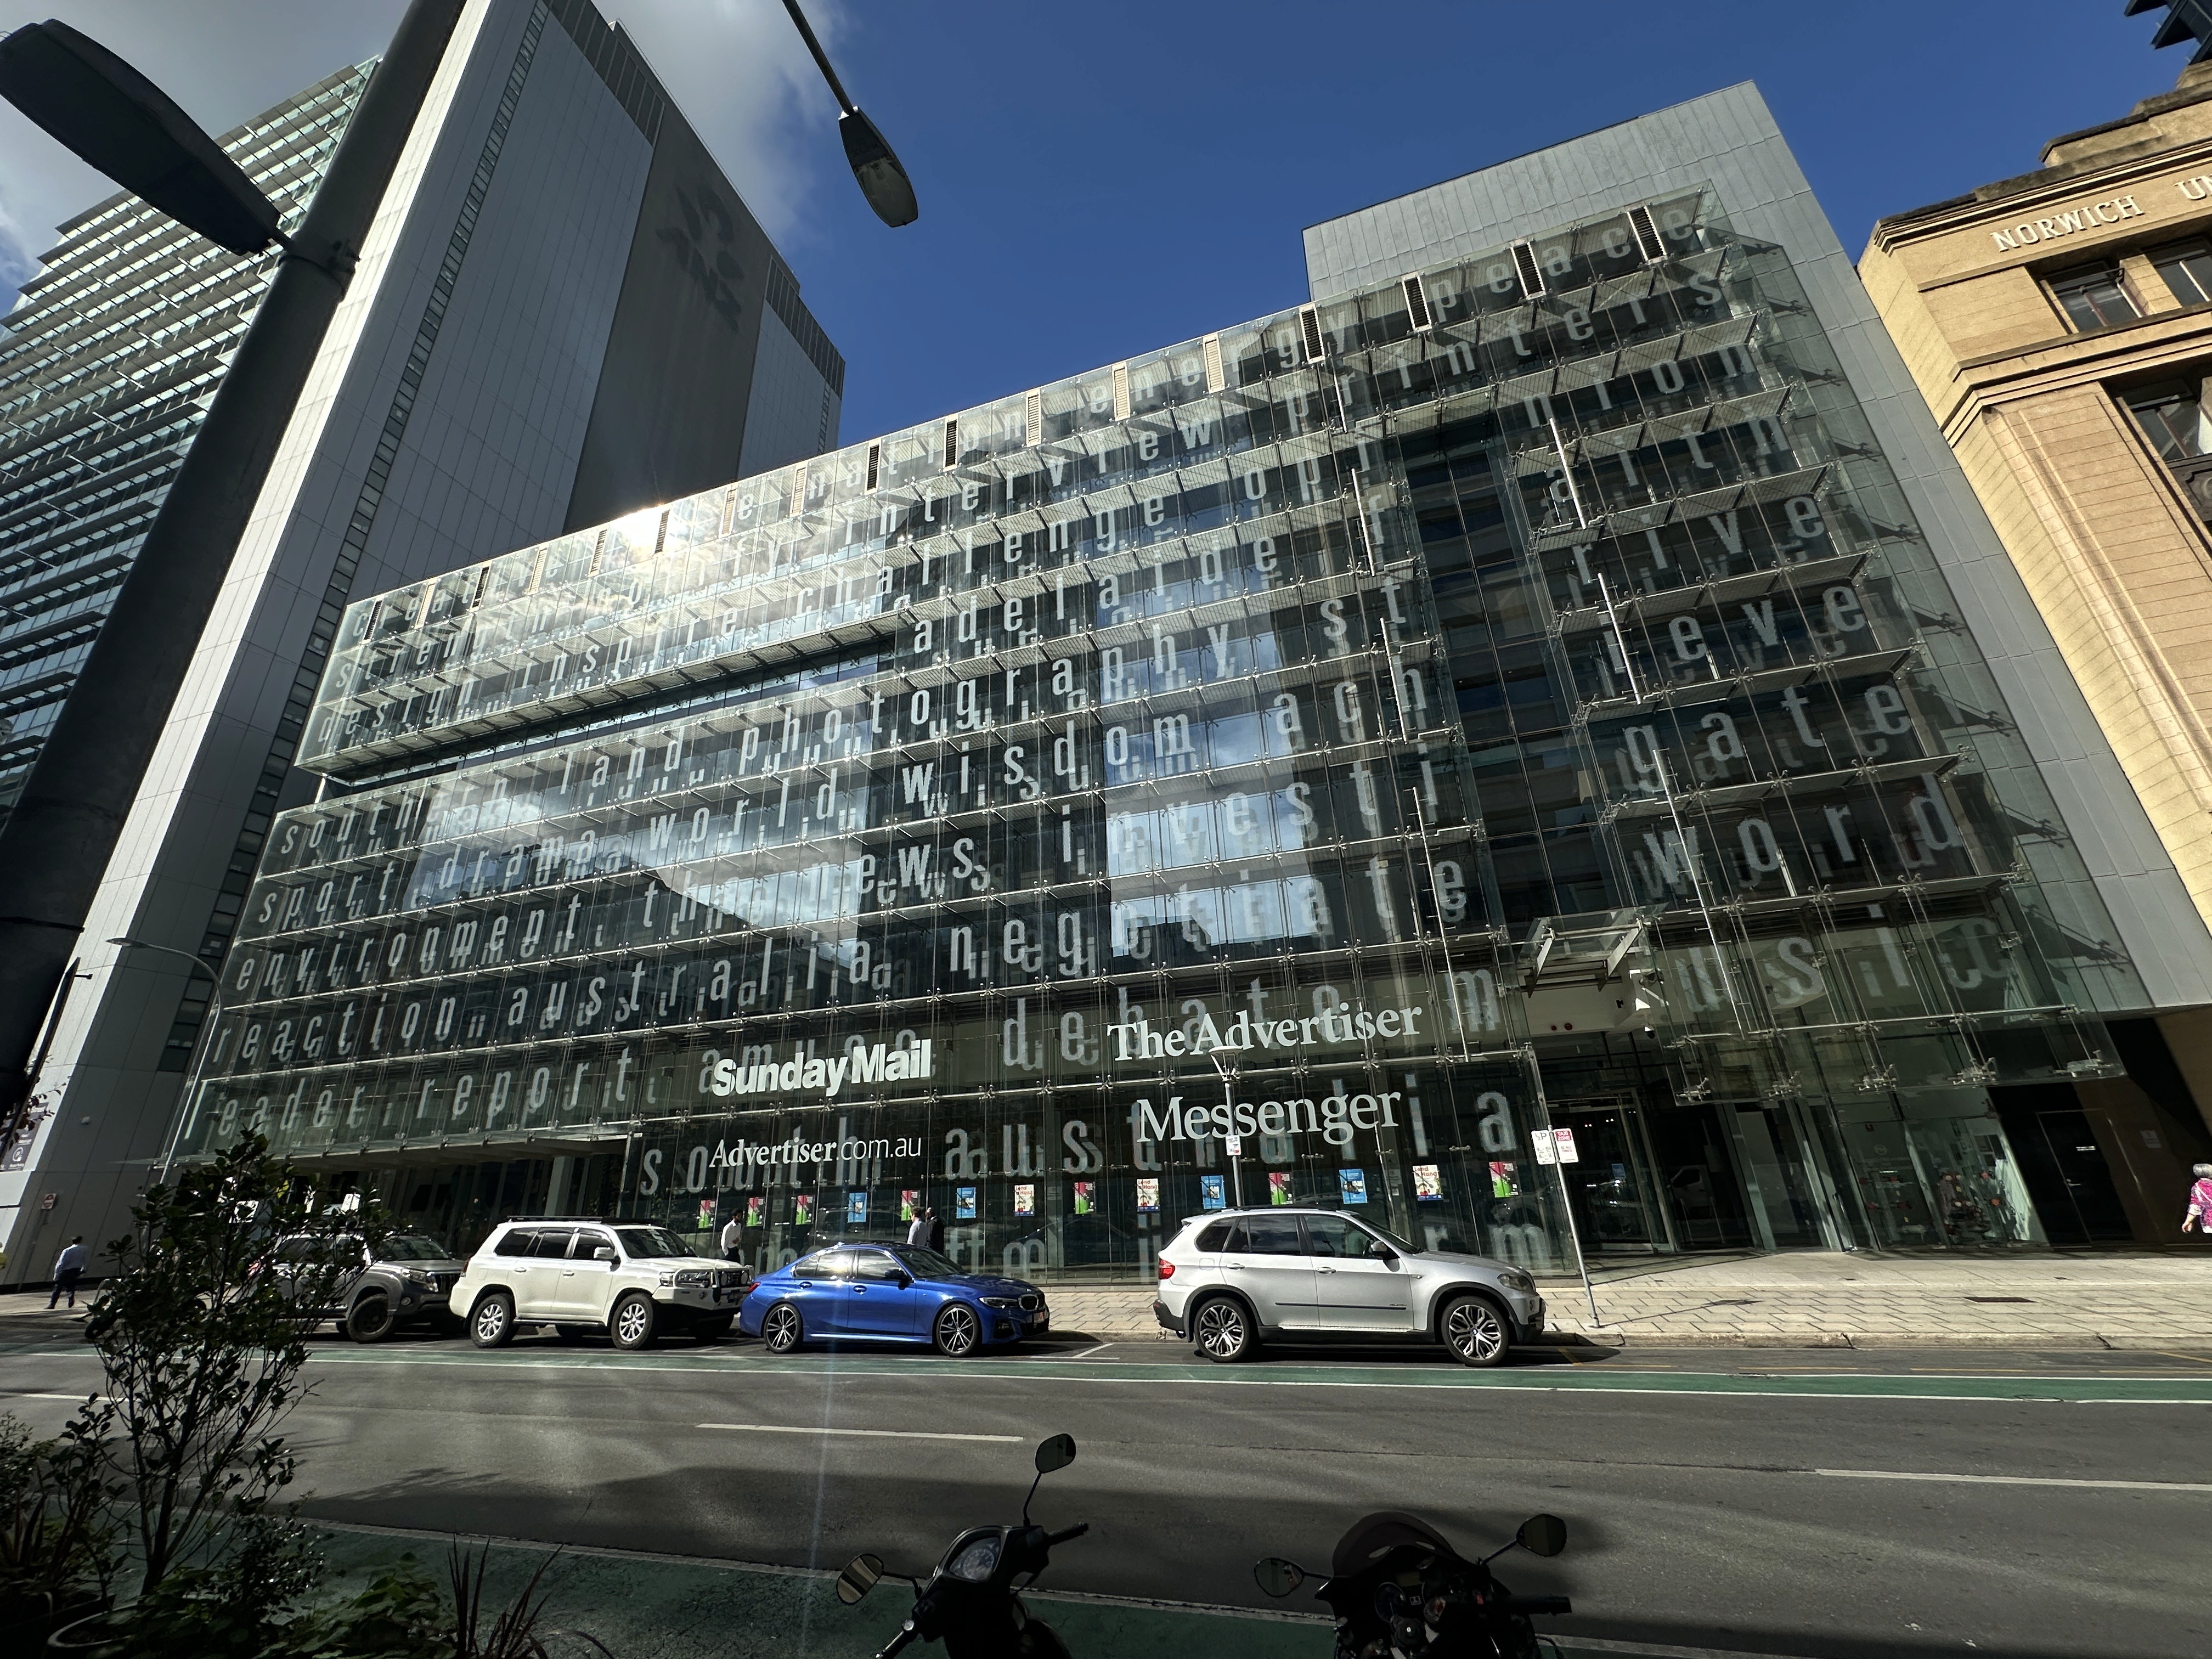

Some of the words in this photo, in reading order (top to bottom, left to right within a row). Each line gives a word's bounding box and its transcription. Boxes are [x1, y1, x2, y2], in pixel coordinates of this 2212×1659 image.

[1432, 205, 1693, 309] peace
[1990, 194, 2145, 253] NORWICH
[845, 421, 1210, 545] interview
[1286, 273, 1721, 434] printers
[318, 680, 473, 743] design
[522, 607, 737, 689] inspire
[798, 496, 1165, 614] challenge
[913, 536, 1277, 654] adelaide
[281, 777, 507, 854] southern
[560, 725, 685, 795] land
[740, 623, 1229, 774] photography
[259, 861, 395, 925] sport
[439, 829, 596, 890] drama
[650, 768, 838, 851] world
[902, 713, 1195, 804] wisdom
[212, 994, 456, 1064] reaction
[507, 931, 870, 1026] australia
[950, 856, 1467, 977] negotiate
[1643, 773, 1961, 883] word
[236, 891, 582, 991] environment
[810, 838, 975, 902] news
[712, 1052, 848, 1097] Sunday
[851, 1039, 932, 1085] Mail
[1107, 1018, 1186, 1062] The
[1189, 1002, 1422, 1056] Advertiser
[184, 1077, 365, 1140] leader
[416, 1047, 633, 1129] report
[1136, 1091, 1401, 1145] Messenger
[708, 1135, 921, 1169] Advertiser.com.au
